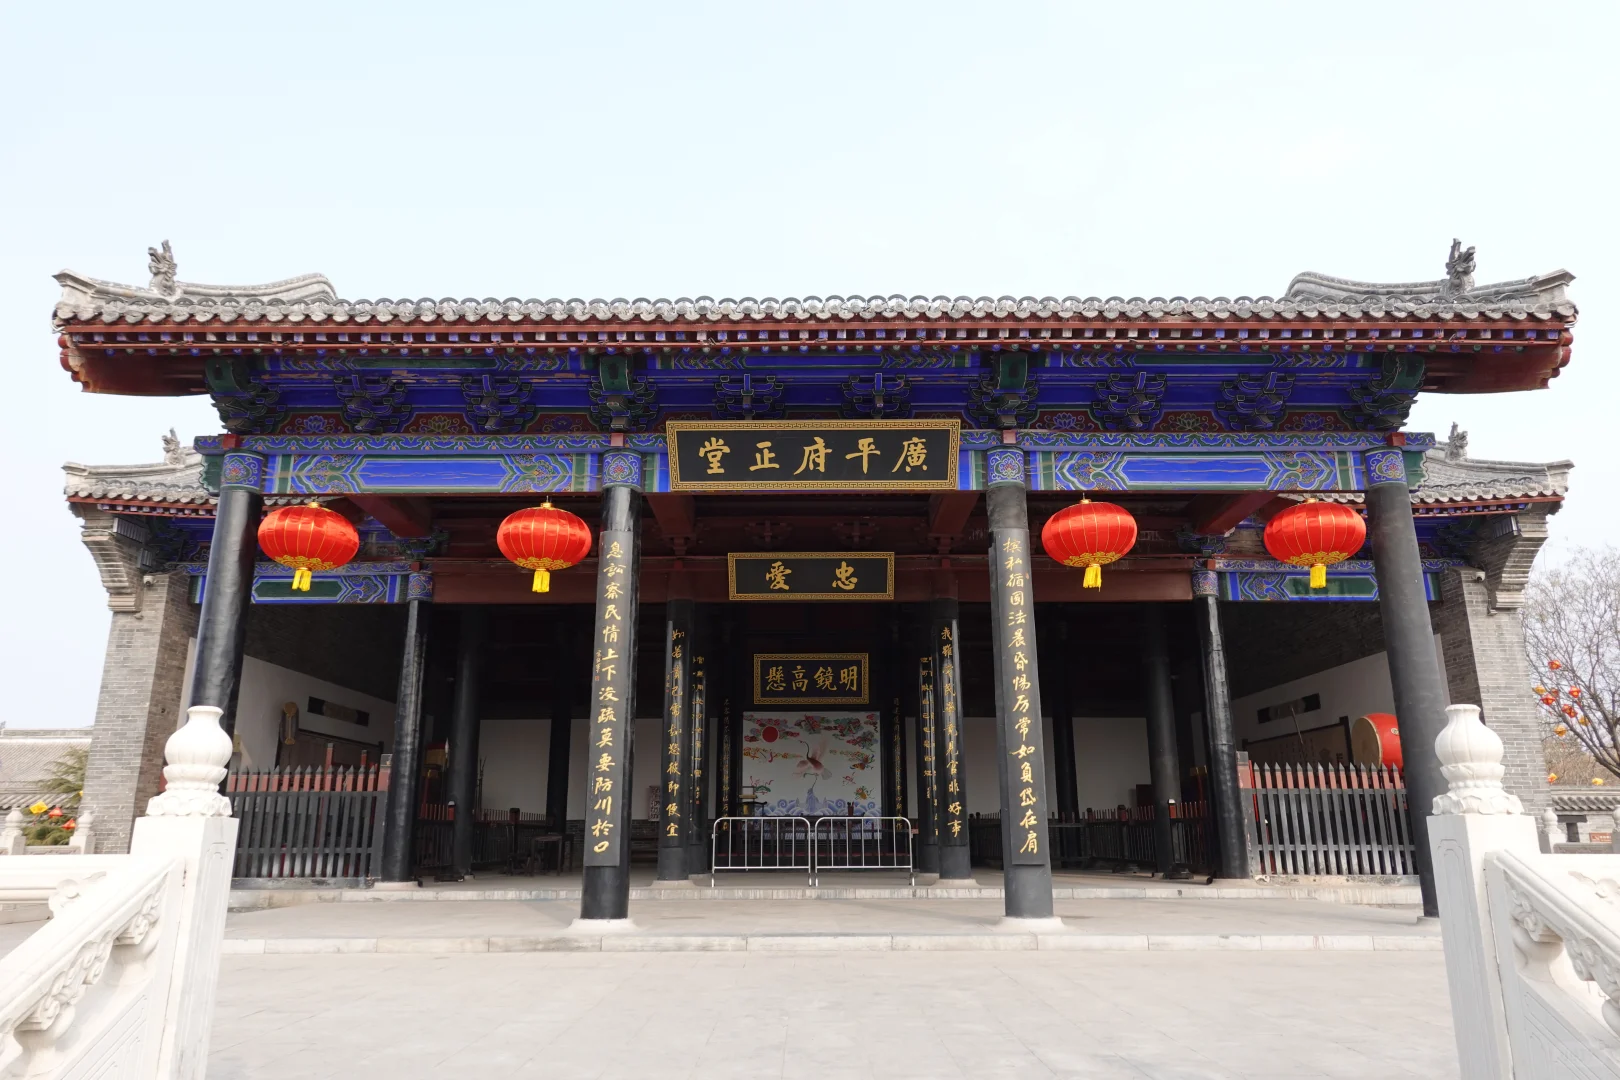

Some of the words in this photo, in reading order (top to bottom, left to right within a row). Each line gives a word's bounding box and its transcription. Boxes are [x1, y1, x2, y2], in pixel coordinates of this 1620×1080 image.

[698, 436, 928, 476] 廣平府正堂
[765, 560, 858, 591] 忠愛
[765, 665, 858, 692] 明鏡高懸
